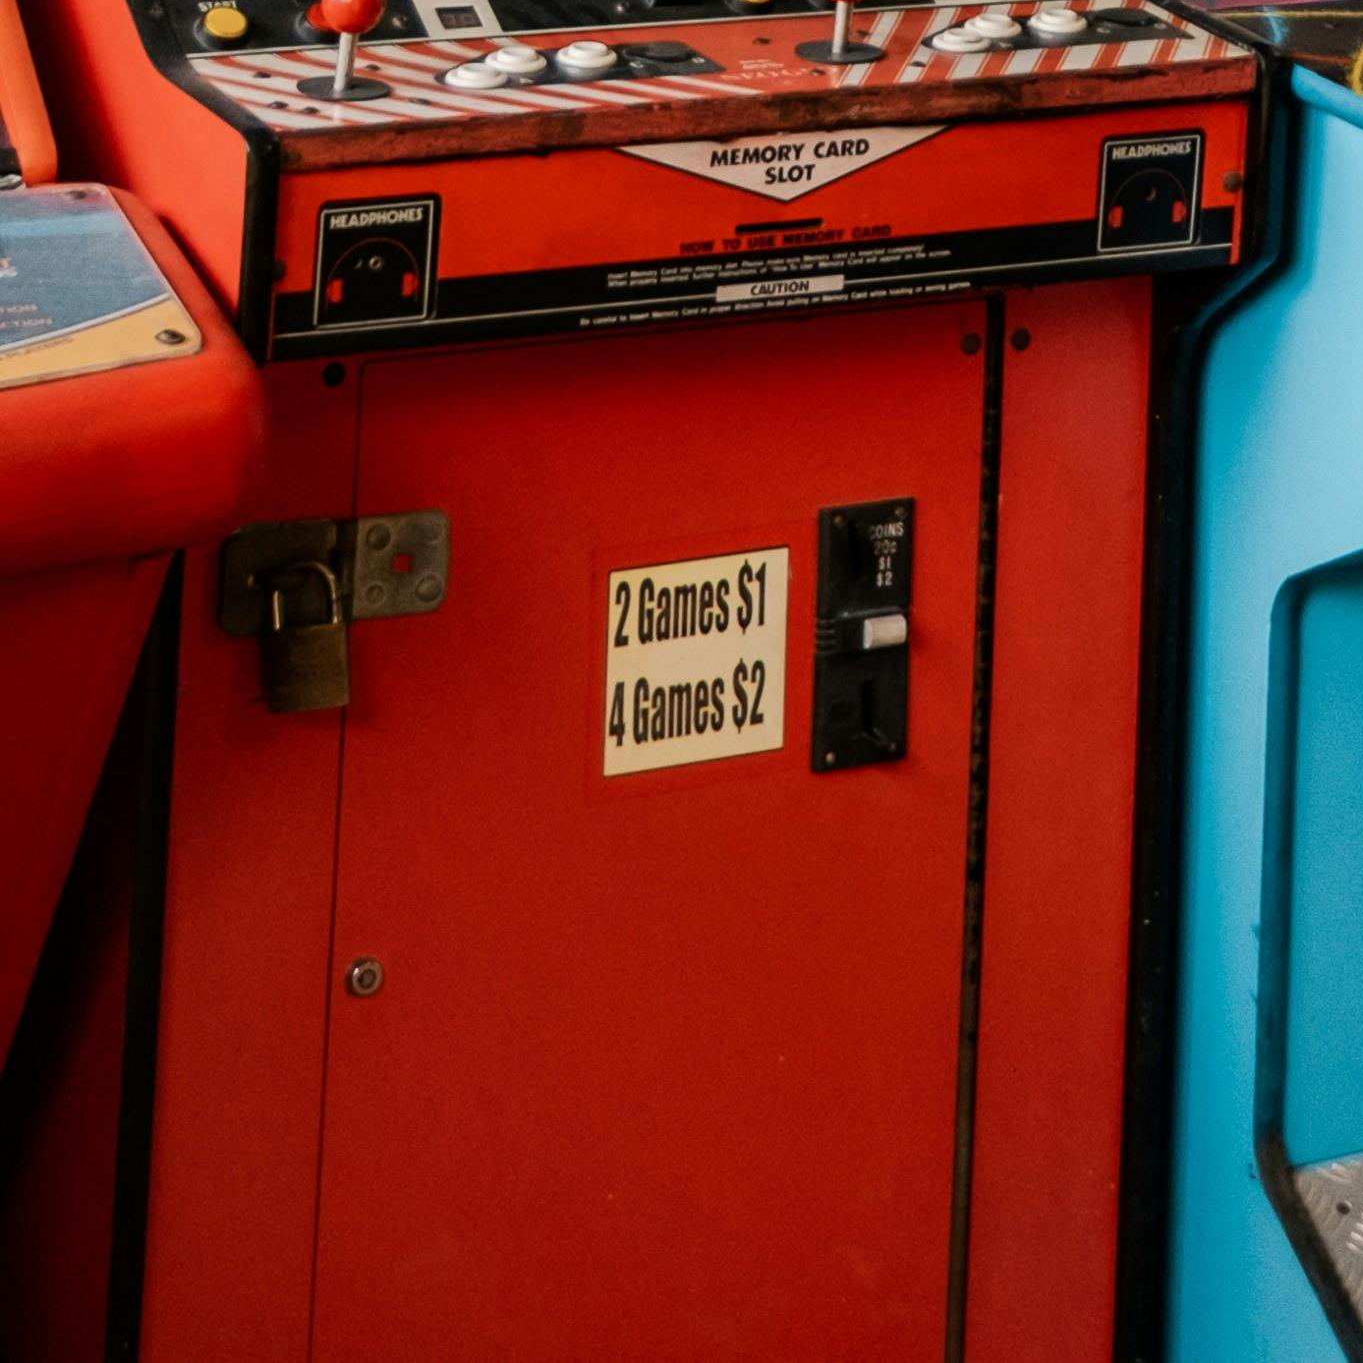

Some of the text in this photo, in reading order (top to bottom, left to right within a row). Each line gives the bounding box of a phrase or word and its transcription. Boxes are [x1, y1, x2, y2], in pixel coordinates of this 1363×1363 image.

[709, 137, 871, 169] MEMORY CARD
[1112, 141, 1192, 160] HEADPHONES
[764, 161, 815, 186] SLOT
[330, 207, 424, 229] HEADPHONES
[680, 241, 715, 256] HOW
[723, 239, 742, 252] TO
[782, 229, 845, 246] MEMORY
[852, 224, 892, 239] CARD
[750, 280, 811, 297] CAUTION
[876, 571, 894, 588] $2
[614, 559, 767, 648] 2 Games $1
[609, 657, 766, 747] 4 Games $2
